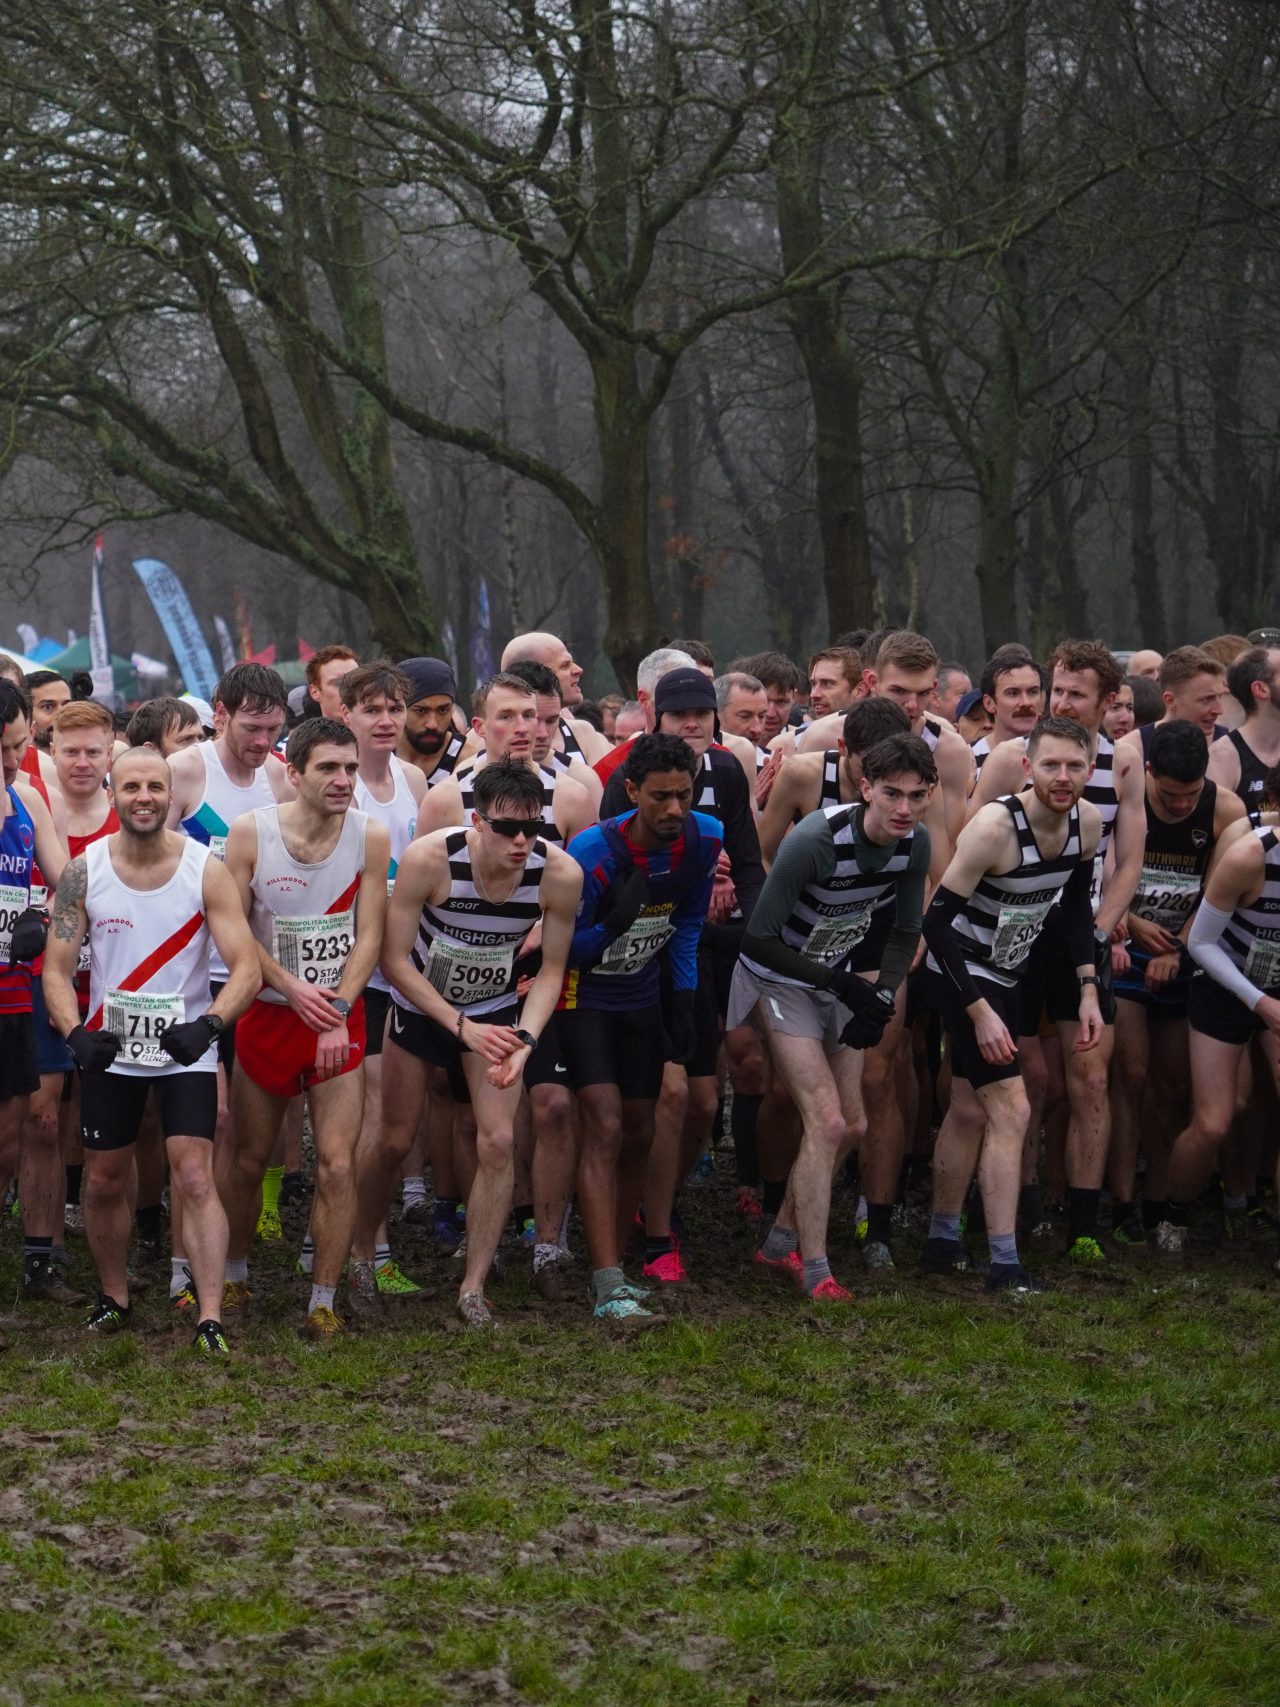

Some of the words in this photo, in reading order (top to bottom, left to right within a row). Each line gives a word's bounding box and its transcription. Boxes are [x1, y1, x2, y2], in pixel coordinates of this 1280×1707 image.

[266, 877, 308, 887] HILLINGDON
[829, 879, 856, 888] soar
[3, 896, 25, 904] LEAGUE
[449, 900, 480, 910] soar
[1146, 889, 1191, 911] 6226
[646, 902, 674, 914] NDON
[96, 918, 134, 929] HILLINGDON
[275, 919, 328, 927] METROPOLITAN
[329, 915, 350, 924] CROSS
[317, 923, 343, 932] LEAGUE
[301, 933, 351, 962] 5233
[436, 940, 487, 957] METROPOLITAN
[441, 949, 474, 961] COUNTRY
[452, 964, 507, 986] 5098
[108, 991, 155, 1004] METROPOLITAN
[464, 988, 498, 997] START
[113, 999, 142, 1010] COUNTRY
[143, 1001, 172, 1010] LEAGUE
